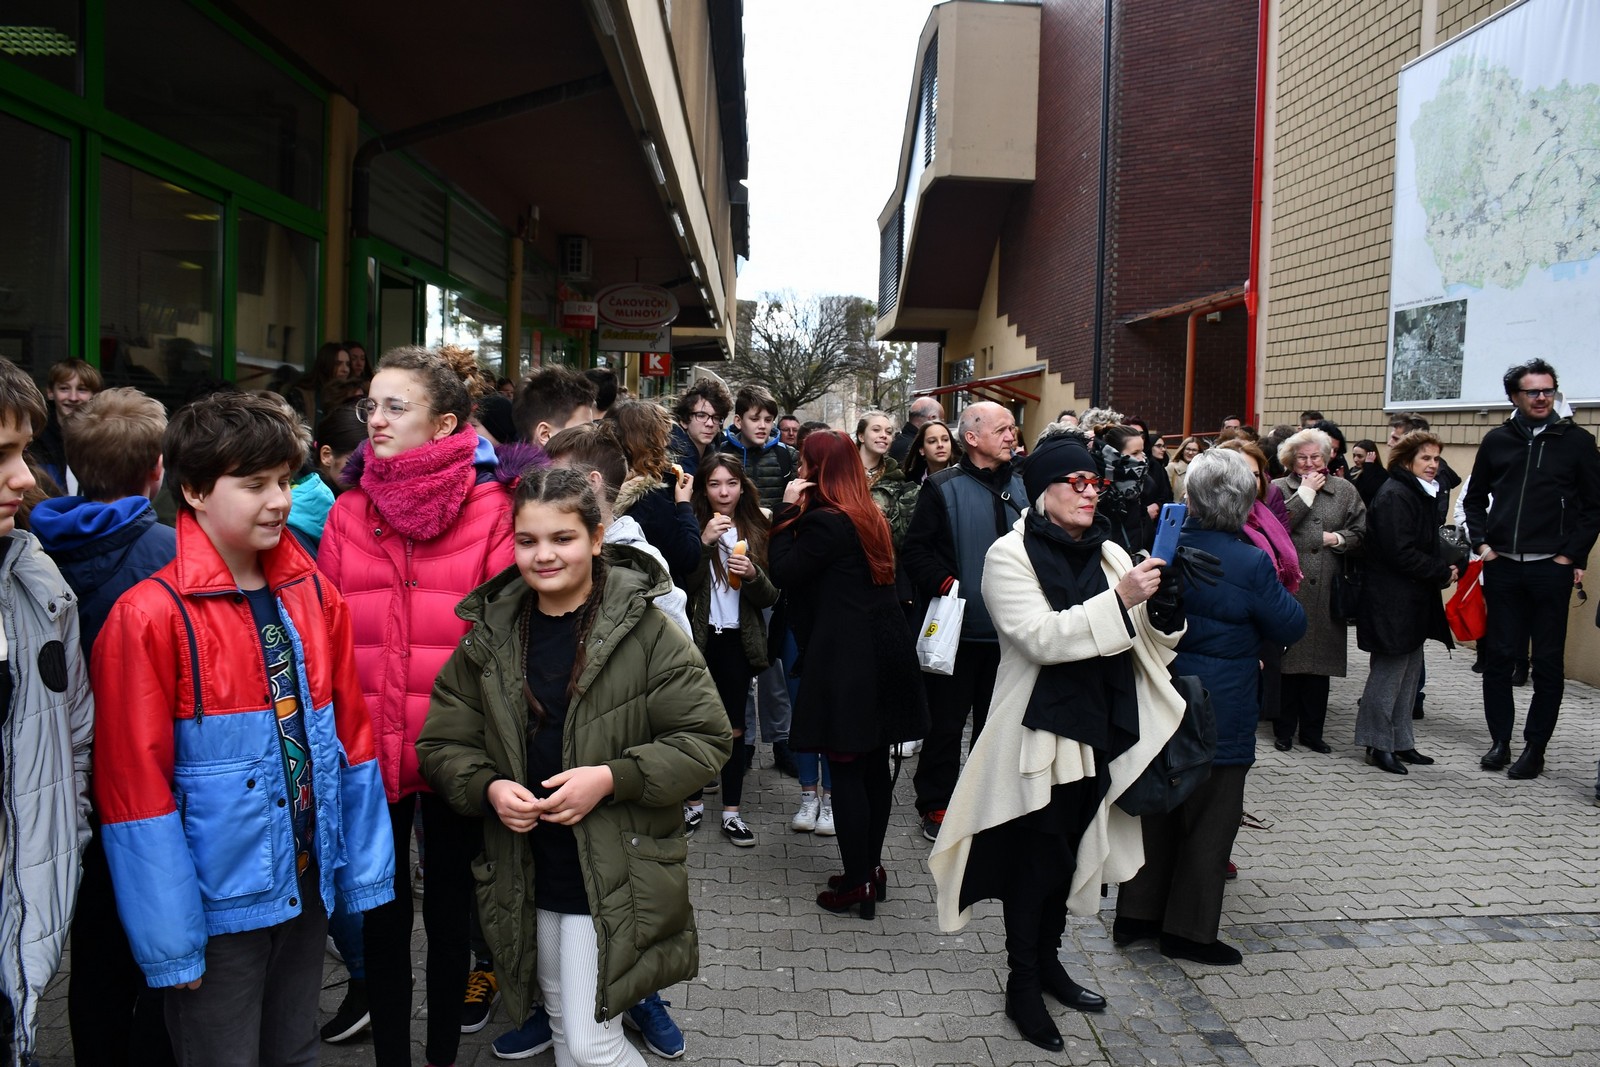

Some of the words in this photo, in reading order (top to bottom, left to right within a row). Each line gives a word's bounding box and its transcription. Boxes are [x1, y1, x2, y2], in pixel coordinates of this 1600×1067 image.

[609, 296, 668, 307] ČAKOVEČKI
[615, 309, 661, 318] MLINOVI
[649, 353, 663, 369] K
